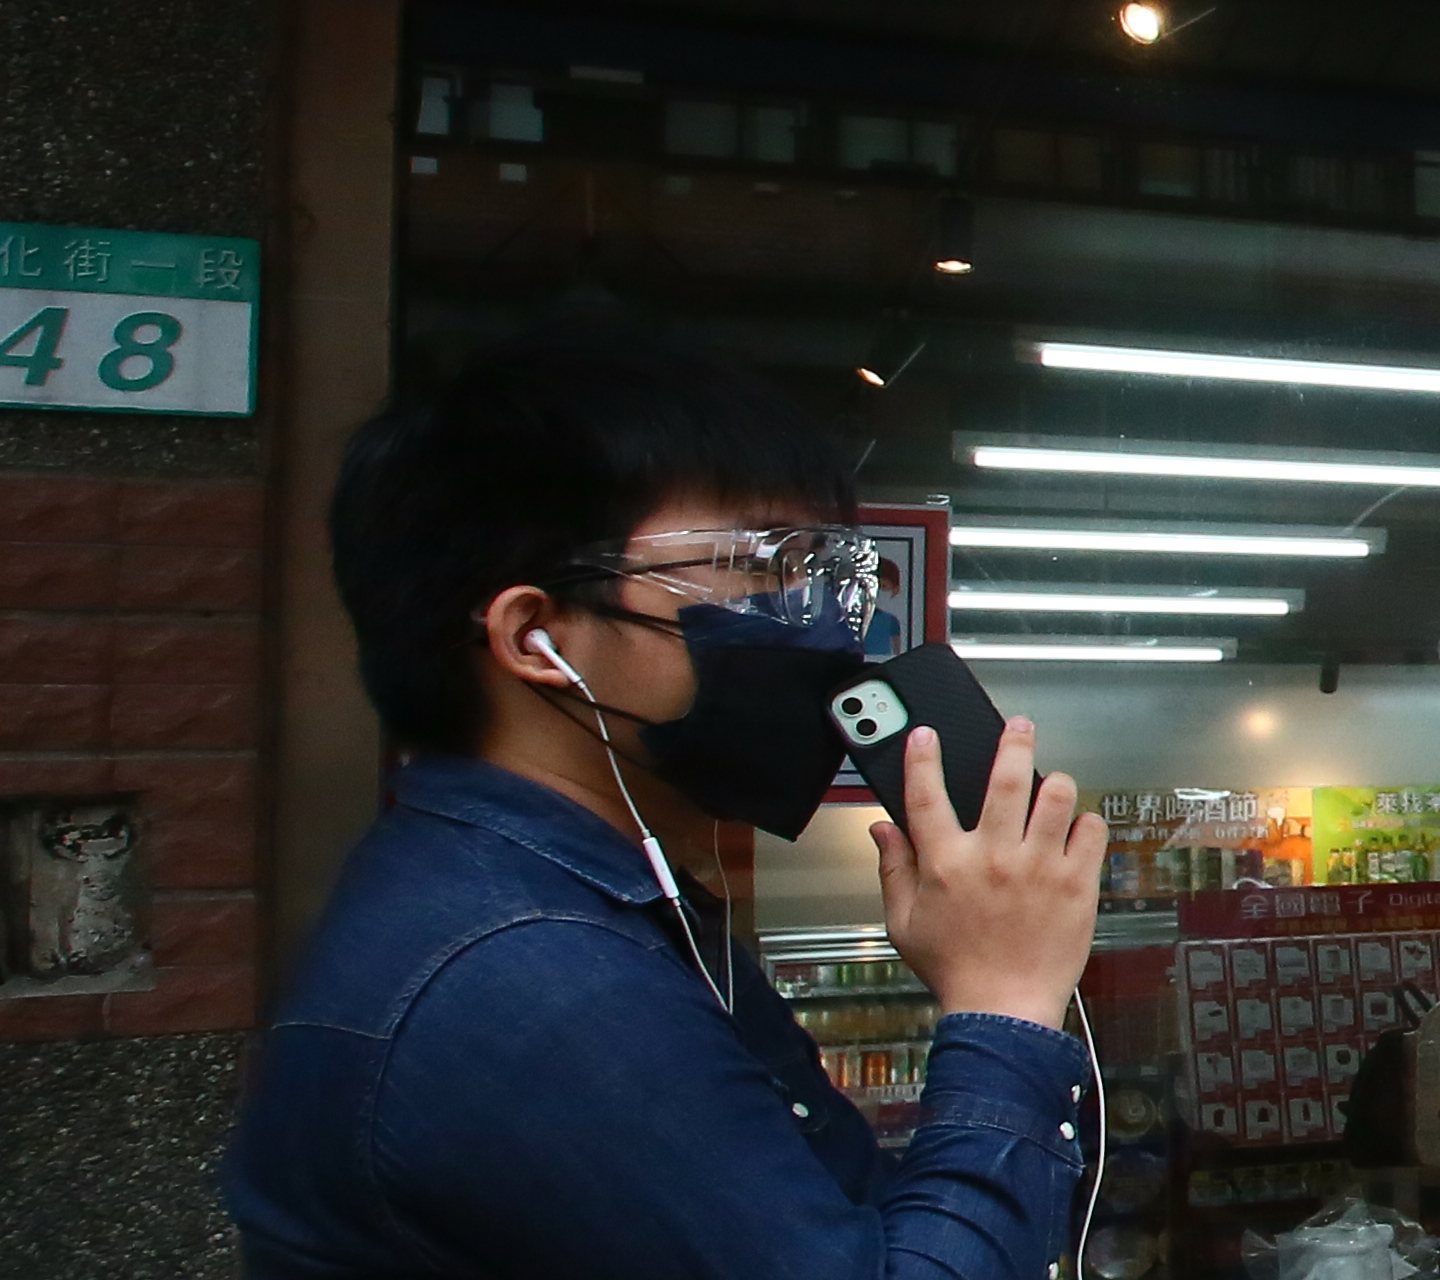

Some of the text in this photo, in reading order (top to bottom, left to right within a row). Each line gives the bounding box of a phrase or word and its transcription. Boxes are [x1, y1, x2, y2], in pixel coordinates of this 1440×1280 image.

[0, 305, 184, 393] 48
[1101, 790, 1260, 827] 世界啤酒節
[1240, 889, 1375, 920] 全國電子
